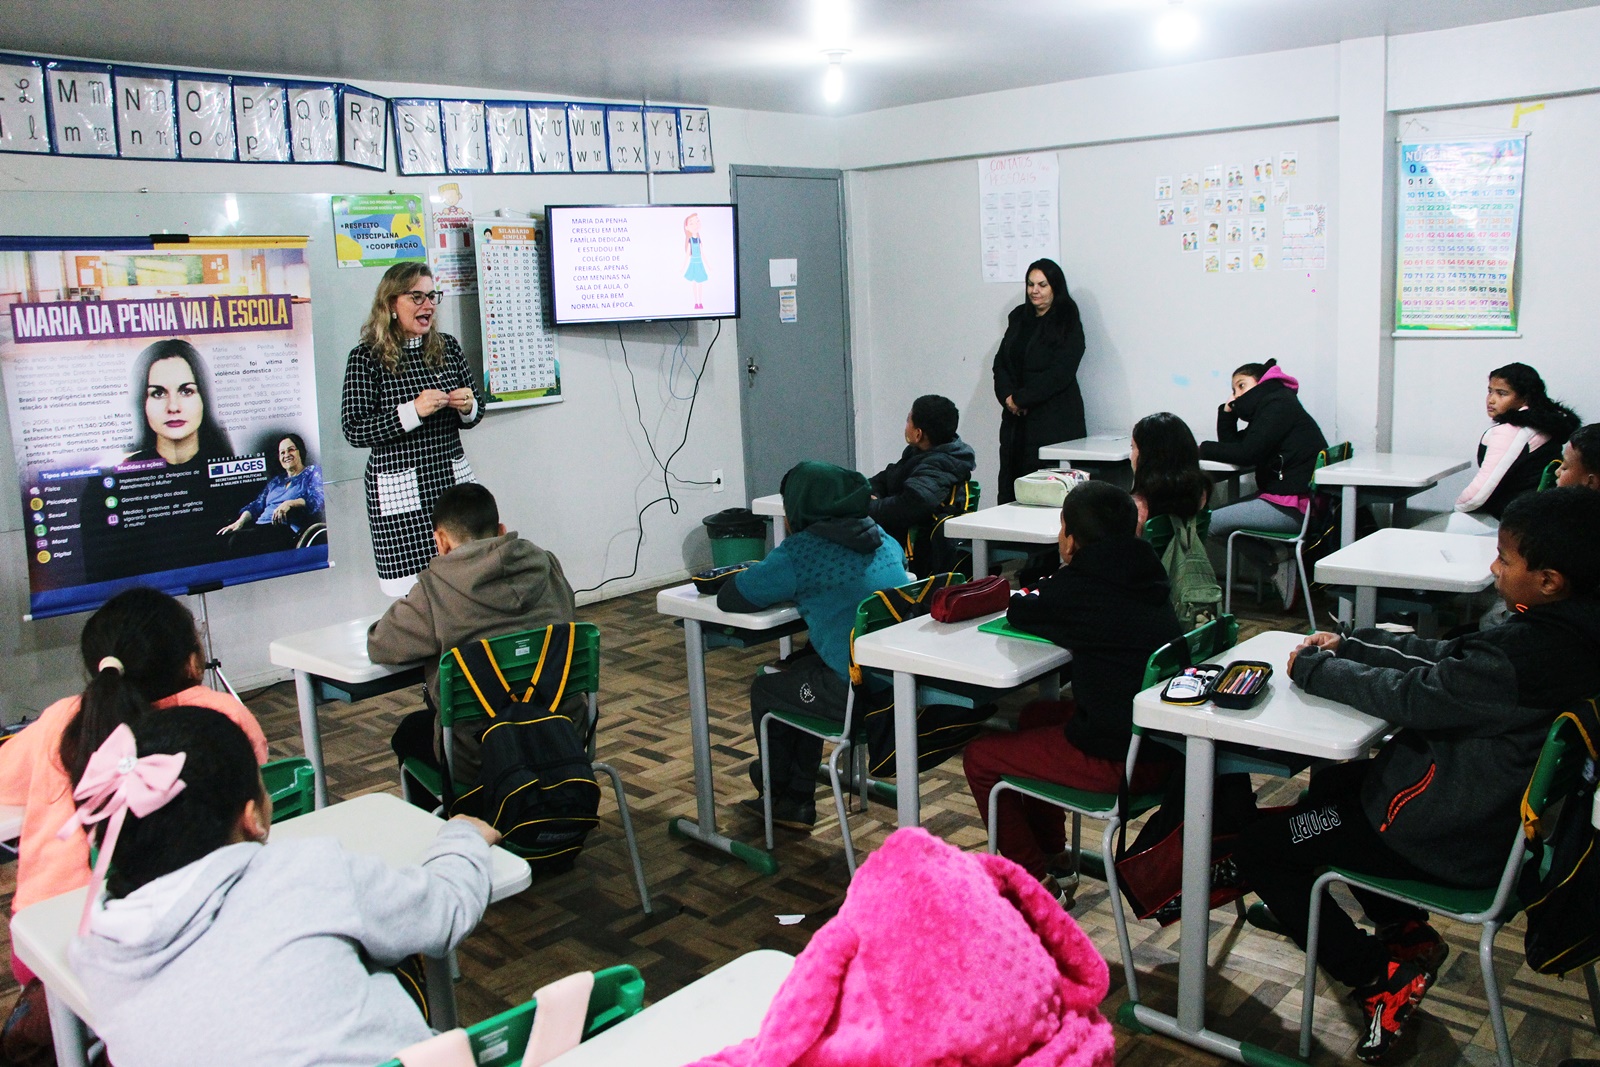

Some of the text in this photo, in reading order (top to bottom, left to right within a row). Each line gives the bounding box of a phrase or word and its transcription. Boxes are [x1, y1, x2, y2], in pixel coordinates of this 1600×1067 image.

[58, 79, 78, 103] M
[125, 88, 141, 111] N
[242, 97, 254, 117] P
[296, 100, 310, 121] Q
[350, 102, 362, 122] R
[404, 114, 415, 133] S
[450, 113, 460, 131] T
[572, 119, 585, 136] W
[686, 115, 694, 131] Z
[64, 126, 81, 141] m
[131, 129, 142, 145] n
[246, 135, 258, 154] p
[353, 138, 359, 151] r
[990, 156, 1032, 171] CONTATOS
[1409, 164, 1416, 173] 0
[357, 231, 399, 240] DISCIPLINA
[581, 293, 595, 301] QUE
[15, 294, 289, 338] MARIA DA PENHA VAI À ESCOLA
[207, 454, 252, 463] PREFEITURA
[226, 460, 264, 473] LAGES
[119, 475, 156, 484] Implementação
[120, 482, 151, 490] Atendimento
[48, 511, 68, 519] Sexual
[147, 505, 170, 513] protetivas
[148, 511, 171, 519] enquanto
[49, 523, 81, 532] Patrimonial
[53, 550, 72, 558] Digital
[1289, 804, 1341, 844] SPORT
